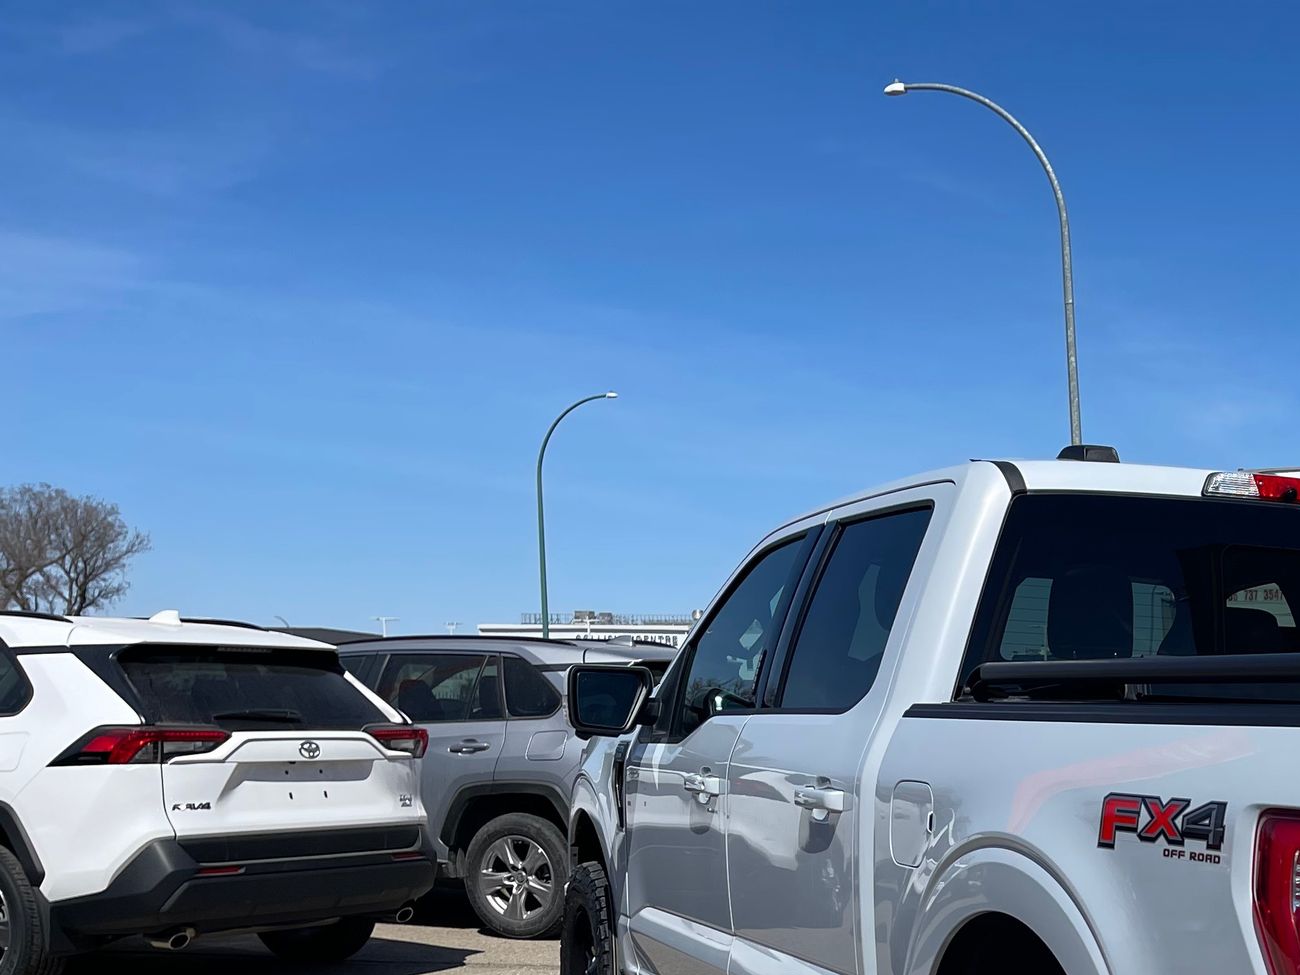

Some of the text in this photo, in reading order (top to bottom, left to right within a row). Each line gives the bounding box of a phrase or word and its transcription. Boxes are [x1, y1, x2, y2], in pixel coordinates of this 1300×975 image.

[1097, 792, 1228, 851] FX4
[1163, 848, 1221, 865] OFF ROAD
